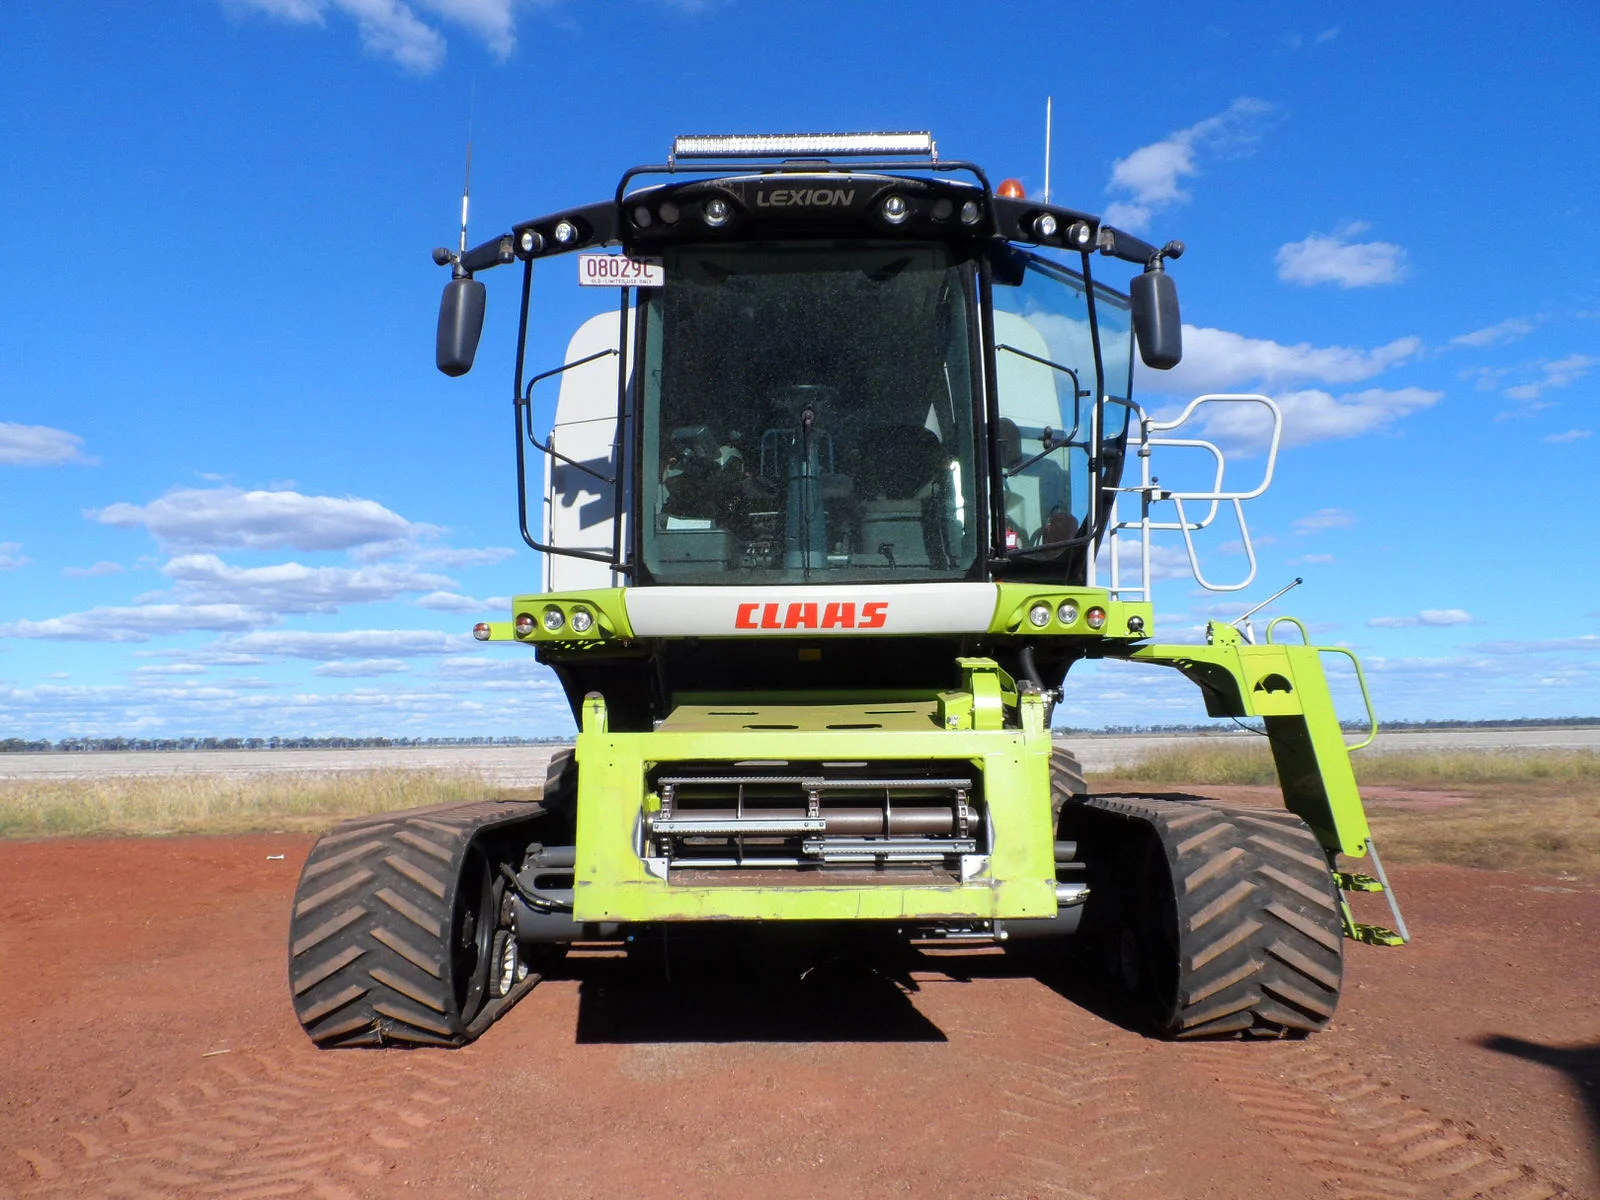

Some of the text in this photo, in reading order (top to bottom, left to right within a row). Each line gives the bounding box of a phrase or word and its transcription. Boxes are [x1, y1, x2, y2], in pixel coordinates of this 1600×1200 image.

[756, 189, 855, 207] LEXION
[587, 258, 654, 278] 08029C
[735, 602, 889, 629] CLAAS
